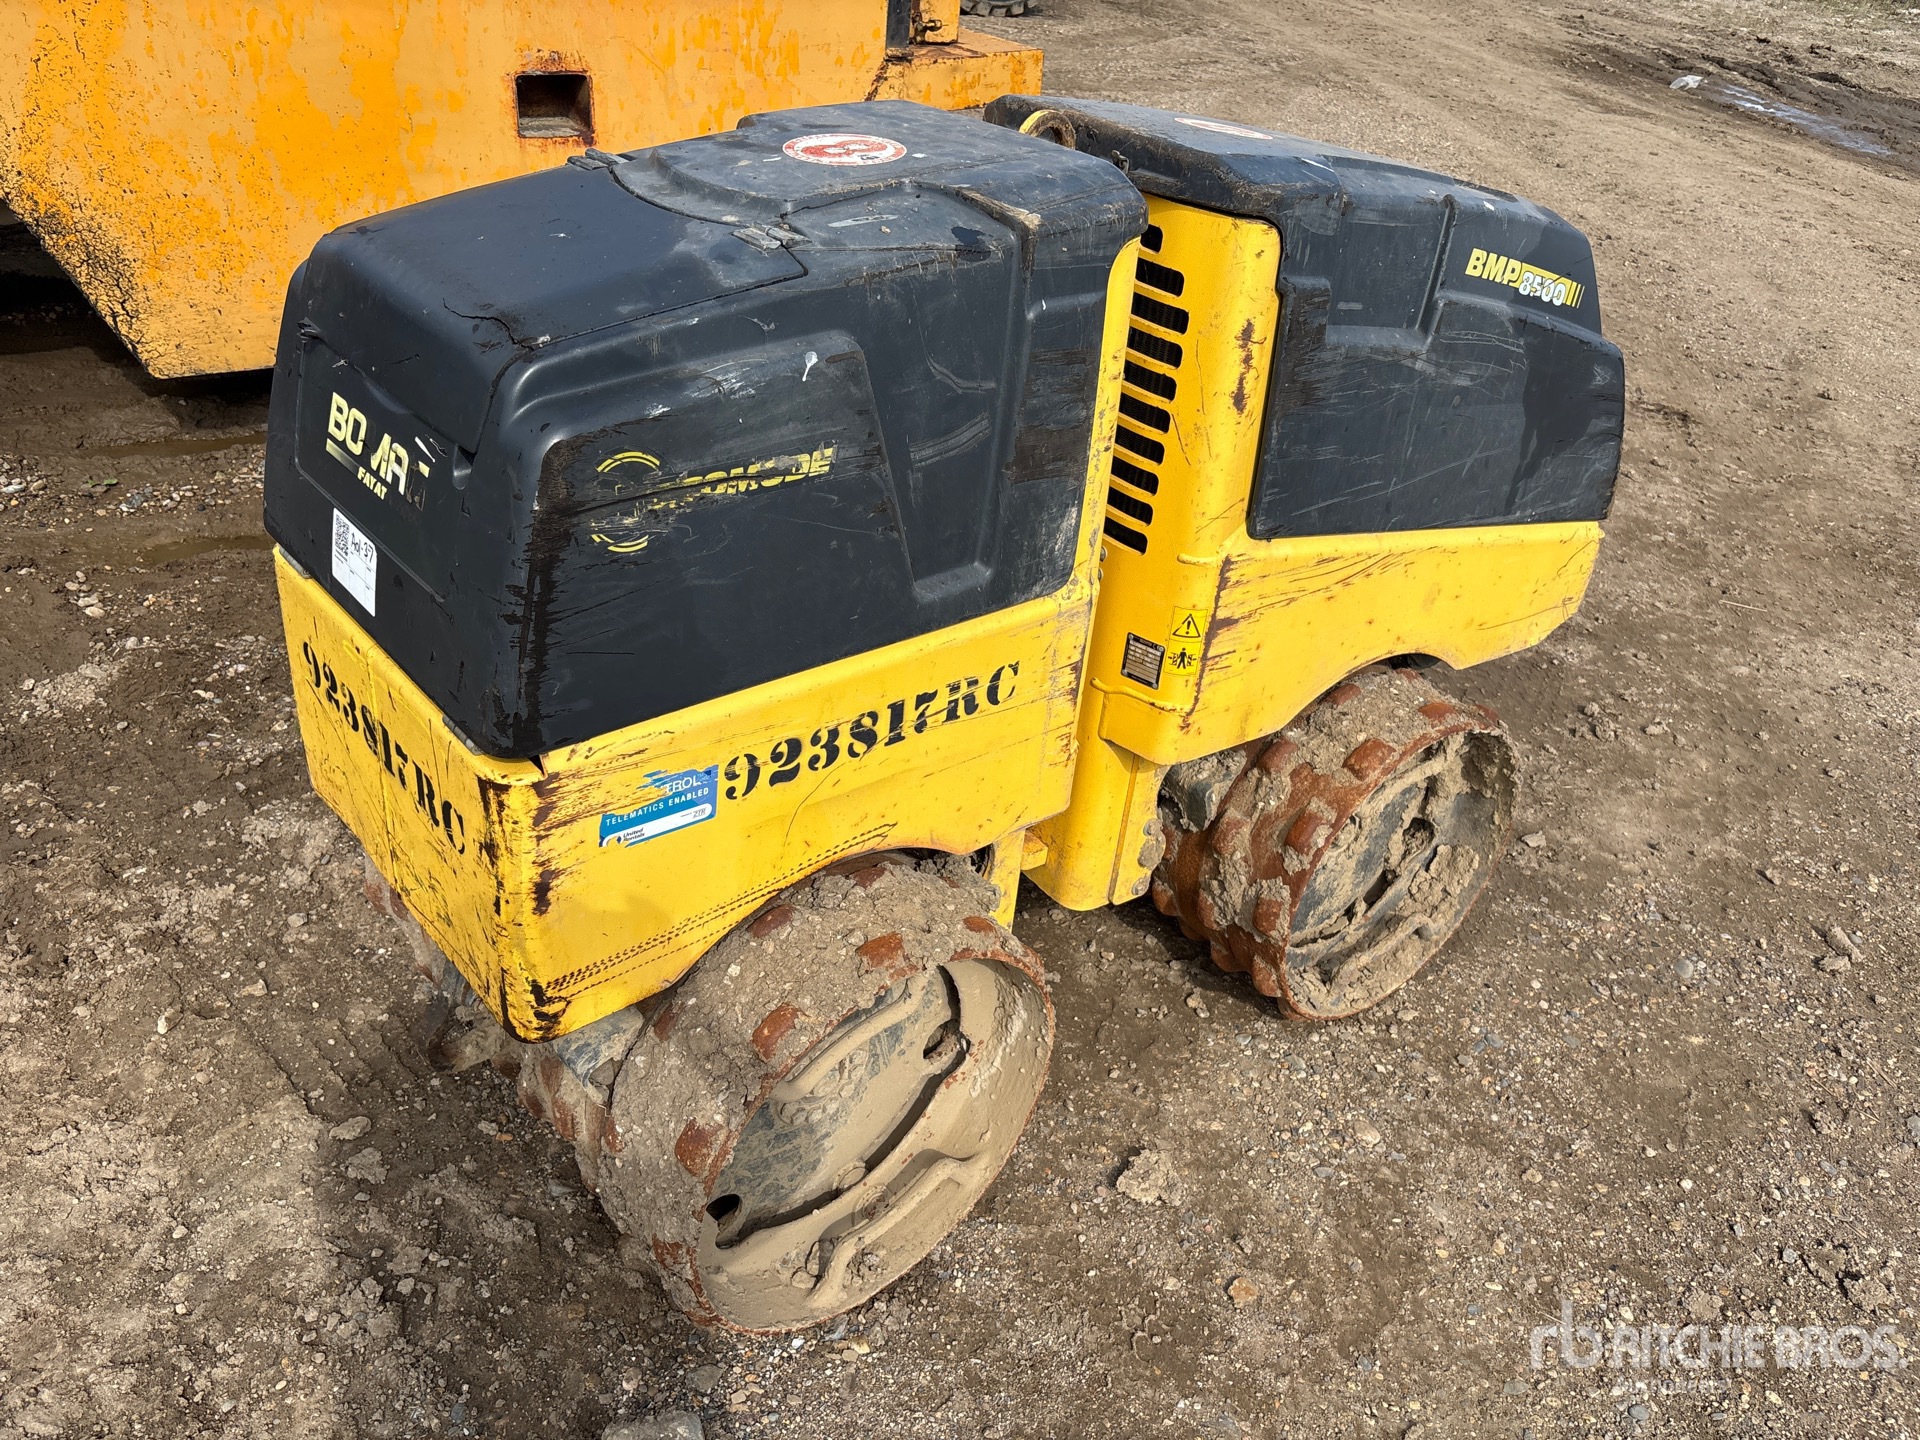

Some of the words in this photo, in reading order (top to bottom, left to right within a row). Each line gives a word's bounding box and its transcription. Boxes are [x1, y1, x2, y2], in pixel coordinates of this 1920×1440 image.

[1464, 247, 1522, 287] BMP
[357, 466, 388, 500] FAYAT
[724, 660, 1020, 801] 923817RC
[605, 801, 664, 826] TELEMATICS
[668, 786, 709, 807] ENABLED
[622, 827, 644, 838] United
